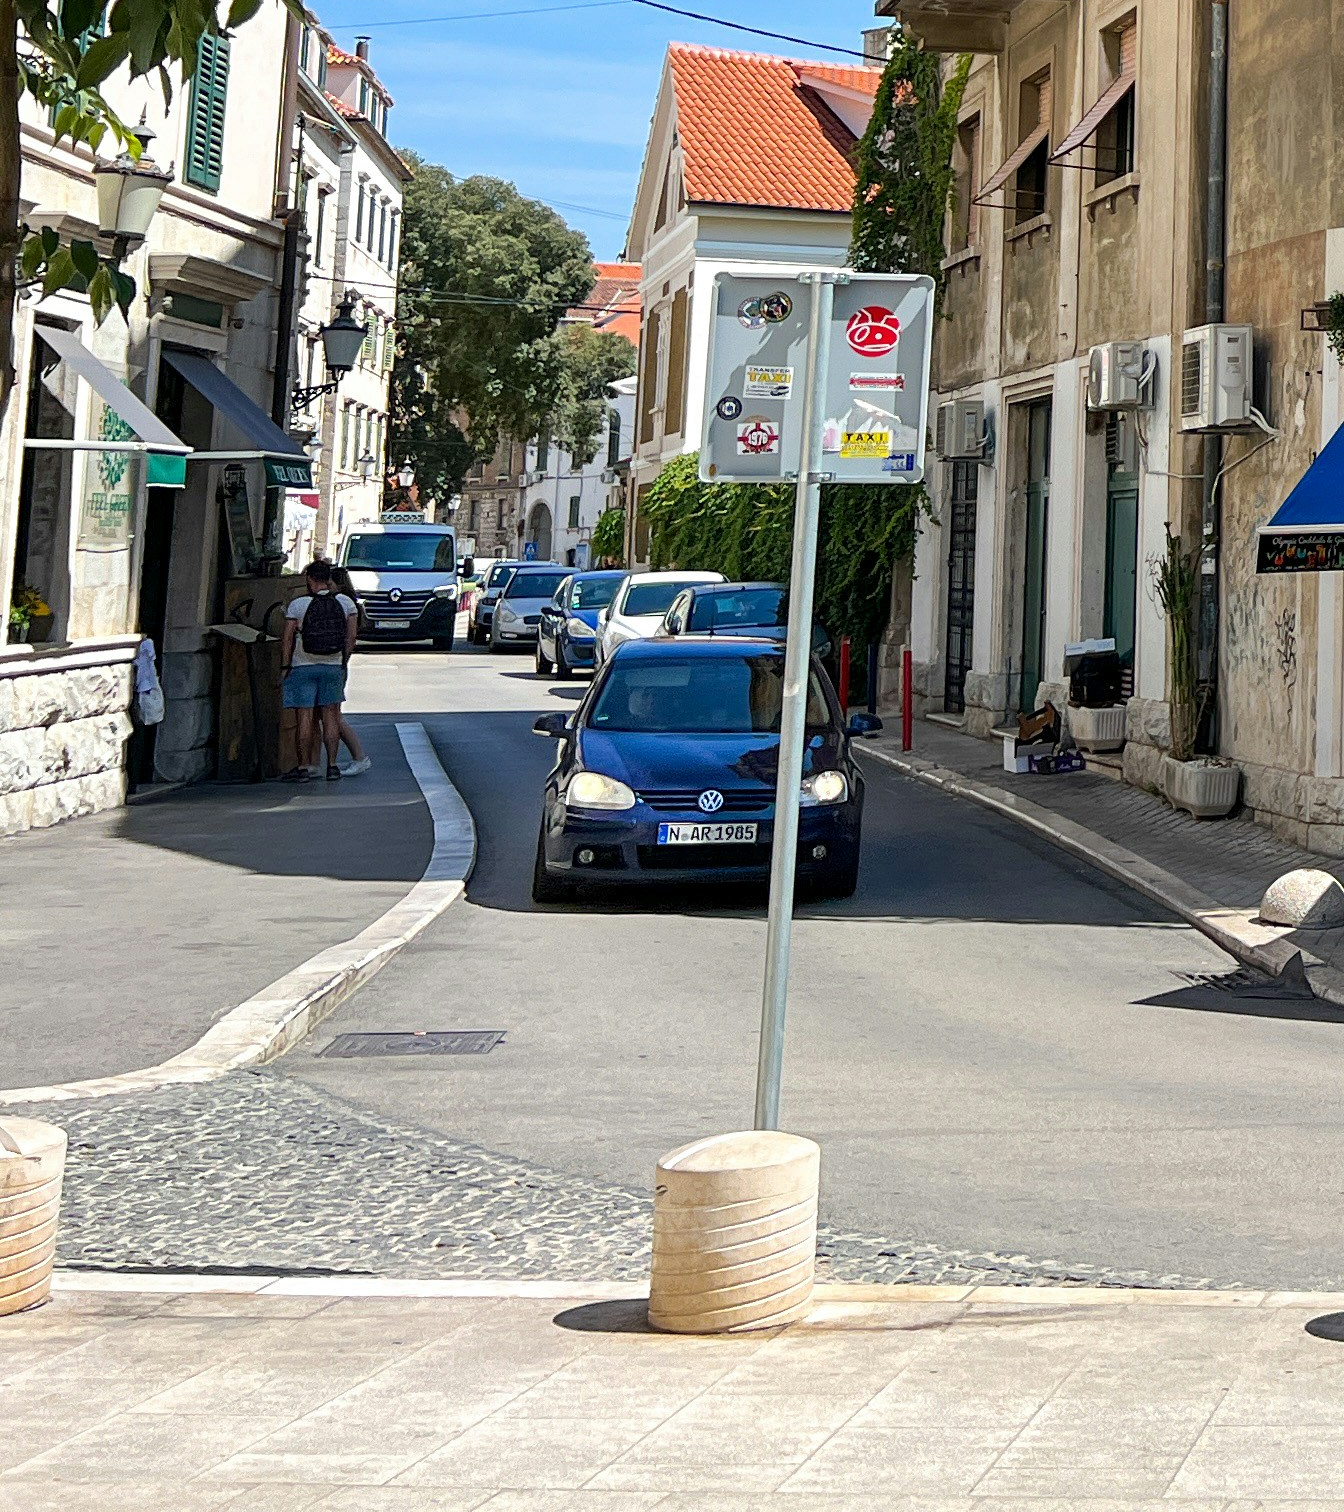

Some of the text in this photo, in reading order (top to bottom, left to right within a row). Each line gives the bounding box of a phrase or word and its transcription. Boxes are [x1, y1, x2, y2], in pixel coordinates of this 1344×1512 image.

[748, 372, 791, 383] TAXI
[845, 433, 884, 441] TAXI
[1298, 535, 1326, 544] Cocktails
[691, 827, 711, 841] AR
[714, 825, 754, 841] 1985
